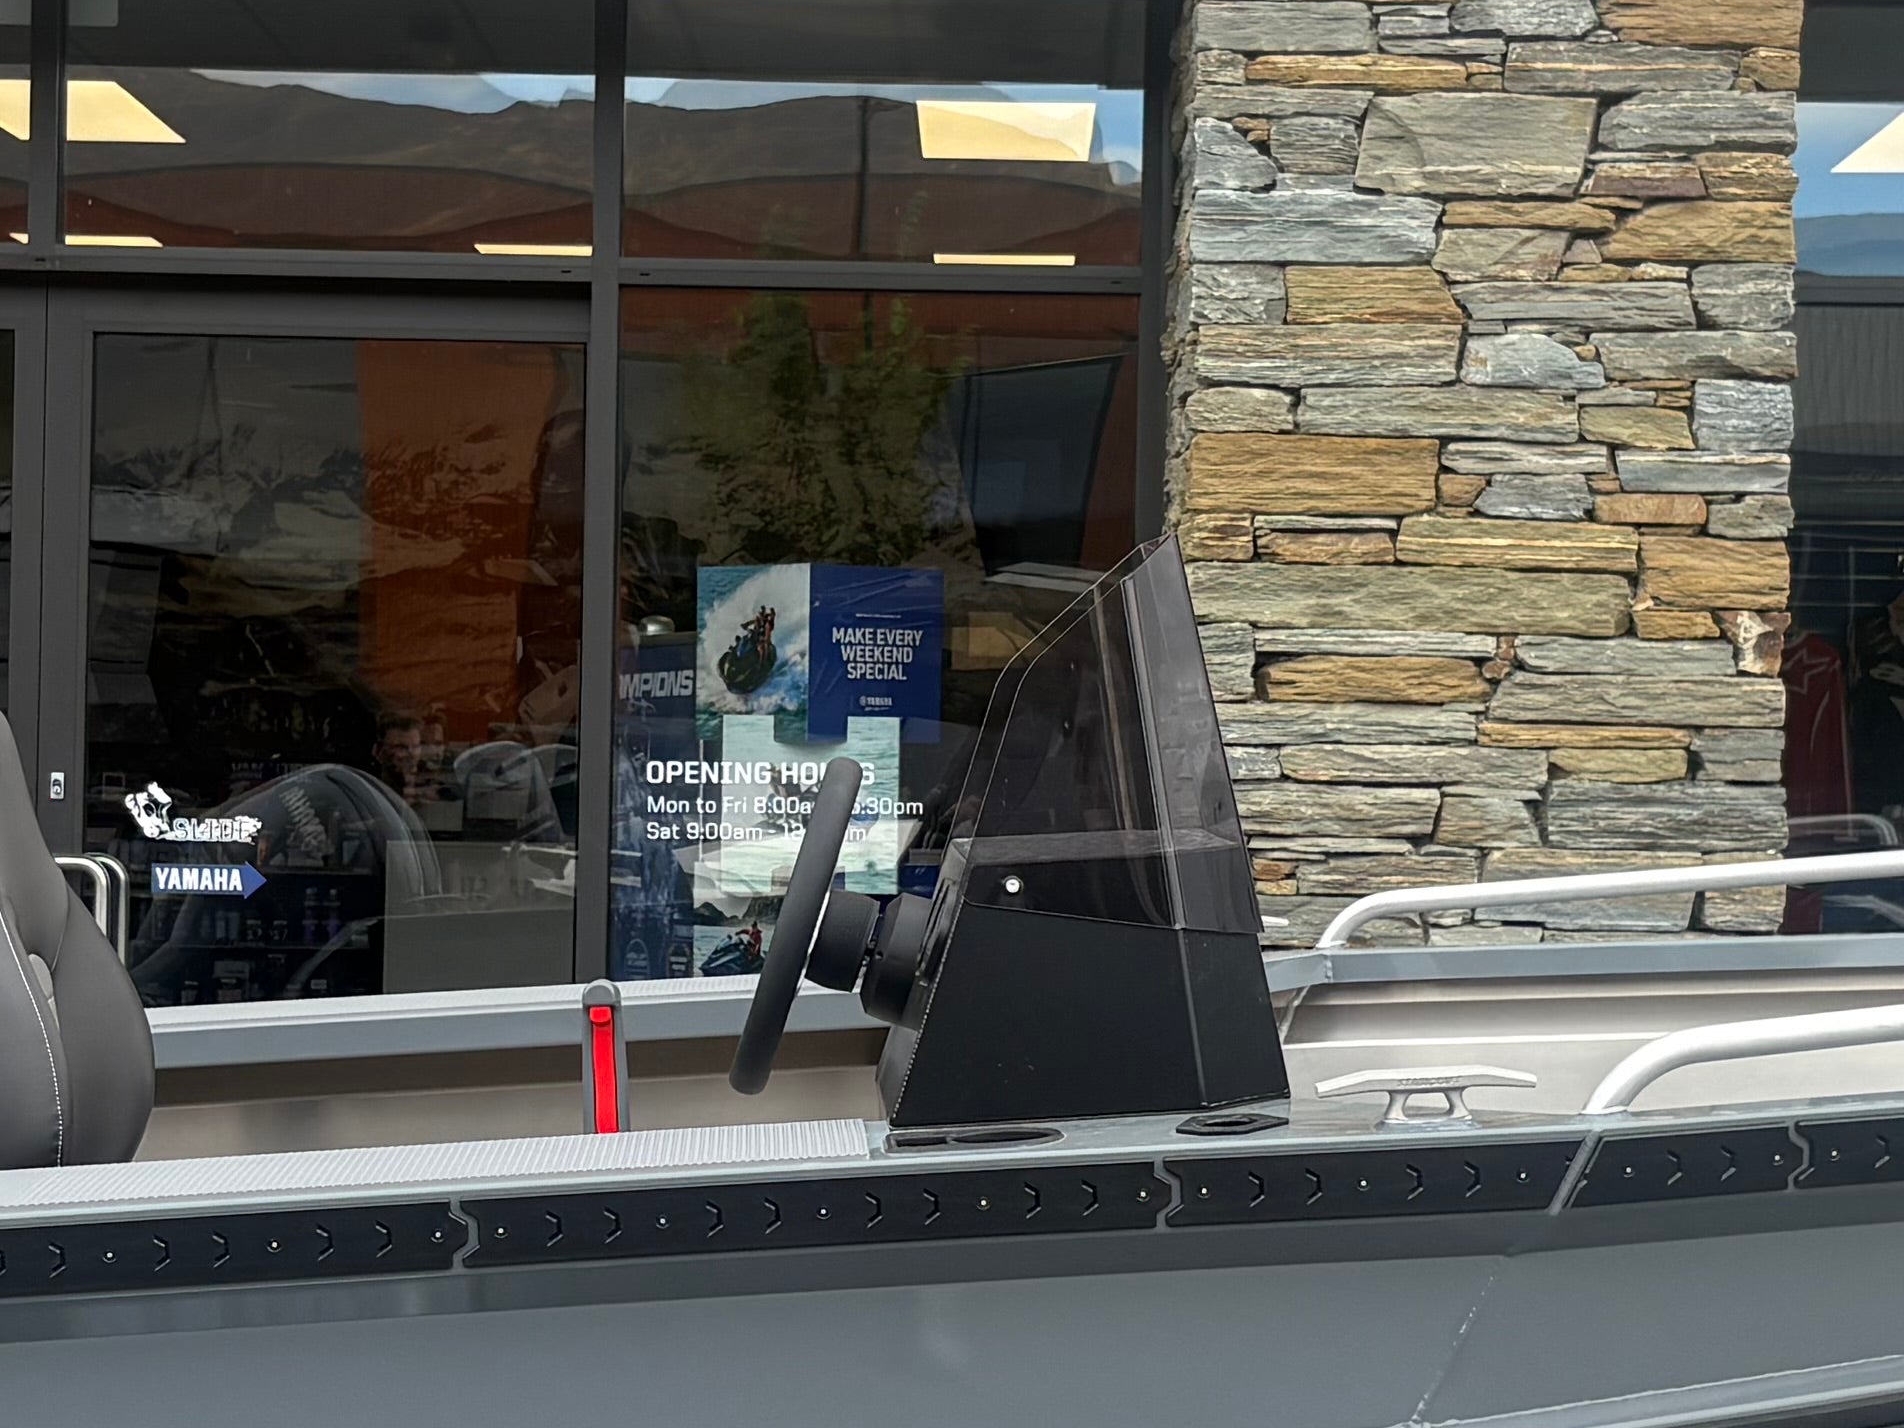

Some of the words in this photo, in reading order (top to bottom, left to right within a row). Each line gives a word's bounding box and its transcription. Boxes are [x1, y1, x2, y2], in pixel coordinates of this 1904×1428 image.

[832, 627, 874, 644] MAKE
[876, 629, 923, 647] EVERY
[840, 644, 913, 664] WEEKEND
[847, 662, 907, 681] SPECIAL
[646, 760, 772, 785] OPENING
[781, 761, 875, 785] HOS
[647, 795, 690, 814] Mon
[696, 796, 717, 814] to
[722, 796, 747, 814] Fri
[753, 796, 816, 815] 8:00a
[647, 822, 680, 840] Sat
[687, 822, 763, 840] 9:00am
[155, 867, 243, 891] YAMAHA
